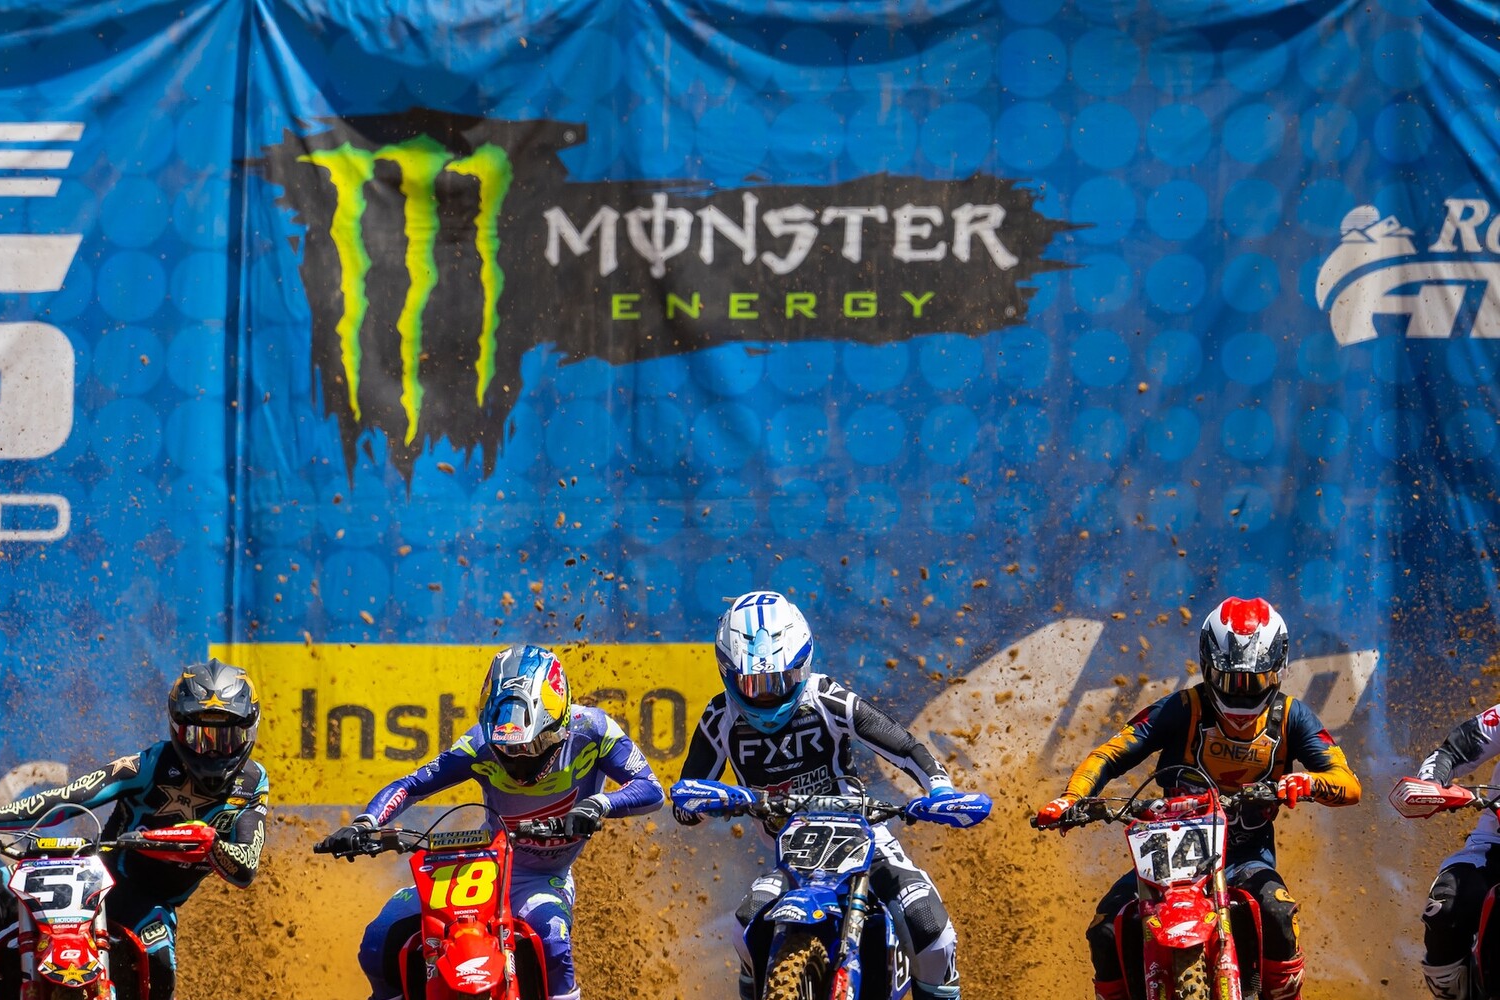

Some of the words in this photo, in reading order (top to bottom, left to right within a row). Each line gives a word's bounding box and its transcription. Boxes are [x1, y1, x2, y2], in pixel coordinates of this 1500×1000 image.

[544, 191, 1019, 279] MONSTER
[1428, 198, 1500, 254] R
[612, 291, 936, 321] ENERGY
[301, 688, 688, 761] Inst0
[740, 727, 824, 765] FXR
[792, 766, 828, 789] GIZMO
[378, 788, 409, 825] HONDA
[38, 837, 83, 849] PROTAPER
[431, 830, 484, 839] RENTHAL
[432, 837, 485, 846] RENTHAL
[782, 825, 869, 870] 97
[1139, 828, 1211, 882] 14
[21, 867, 103, 912] 51
[428, 860, 499, 910] 18
[453, 908, 479, 916] HONDA
[1167, 931, 1199, 940] HONDA
[456, 969, 491, 977] HONDA
